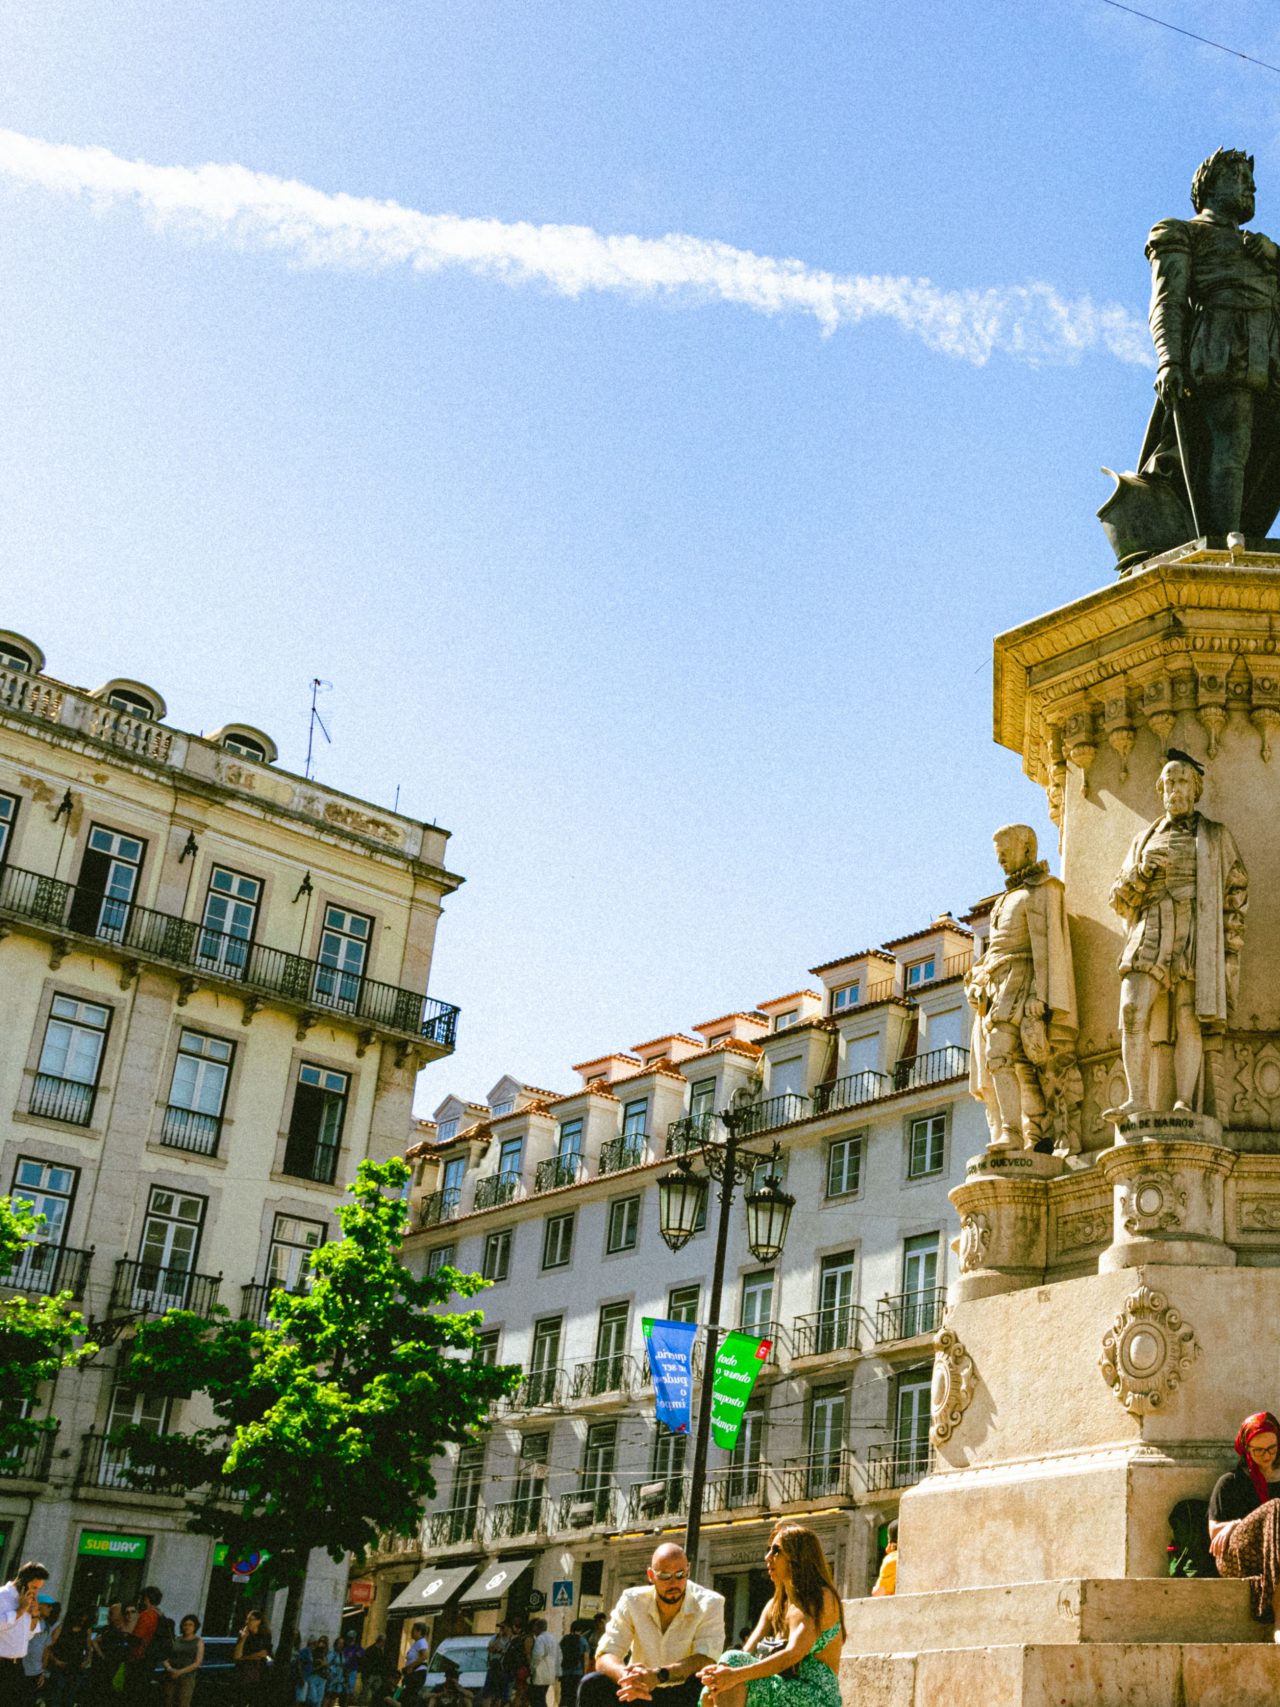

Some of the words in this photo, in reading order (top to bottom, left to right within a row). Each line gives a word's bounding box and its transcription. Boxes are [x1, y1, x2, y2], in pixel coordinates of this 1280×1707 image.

[990, 1158, 1033, 1168] QUEVEDO
[717, 1353, 738, 1367] todo
[715, 1367, 722, 1375] o
[84, 1539, 141, 1553] SUBWAY
